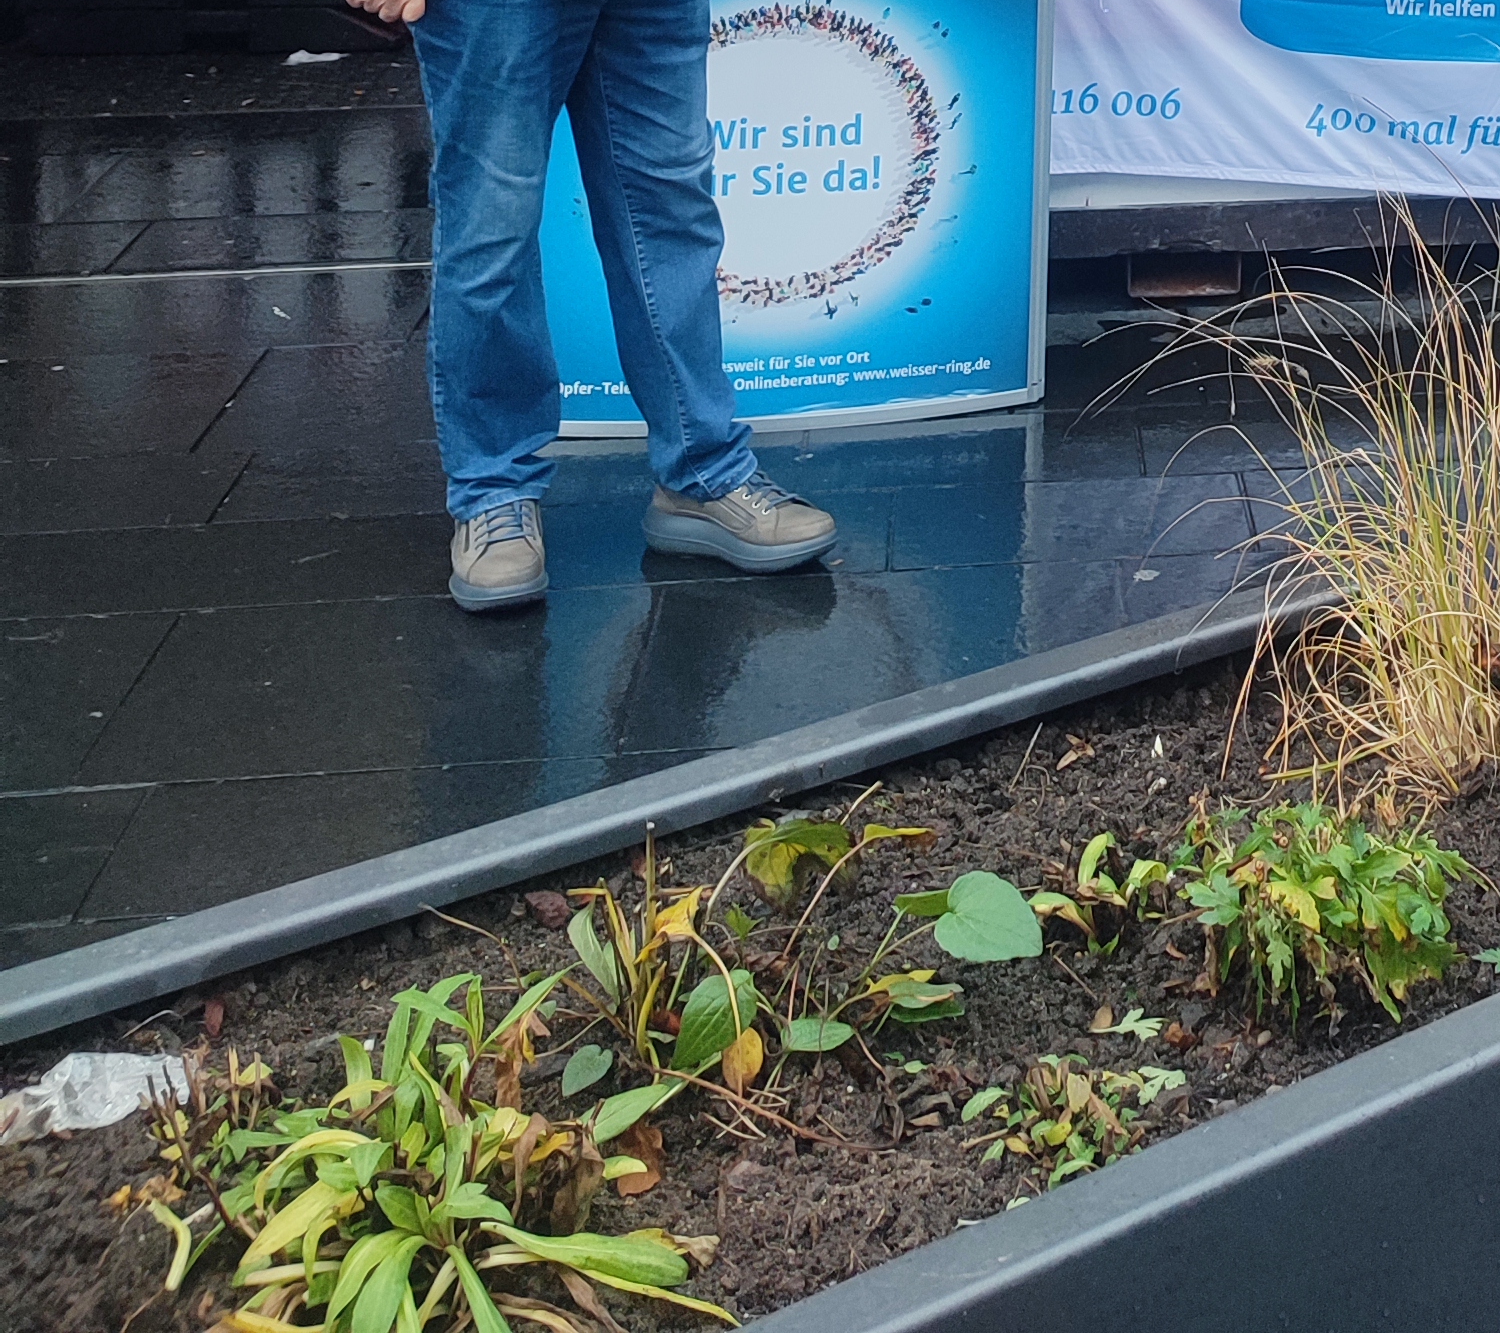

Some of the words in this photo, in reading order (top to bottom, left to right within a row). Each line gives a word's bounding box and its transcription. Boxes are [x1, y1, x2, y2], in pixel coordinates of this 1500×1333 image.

[1112, 87, 1181, 120] 006
[713, 117, 767, 150] Wir
[782, 113, 862, 148] sind
[1305, 103, 1376, 138] 400
[1386, 112, 1457, 147] mal
[752, 162, 808, 196] Sie
[823, 155, 881, 192] da!
[733, 371, 849, 391] Onlineberatung:
[852, 357, 991, 383] www.weisser-ring.de
[768, 356, 791, 372] für
[795, 355, 815, 369] Sie
[819, 354, 843, 367] vor
[847, 350, 870, 364] Ort
